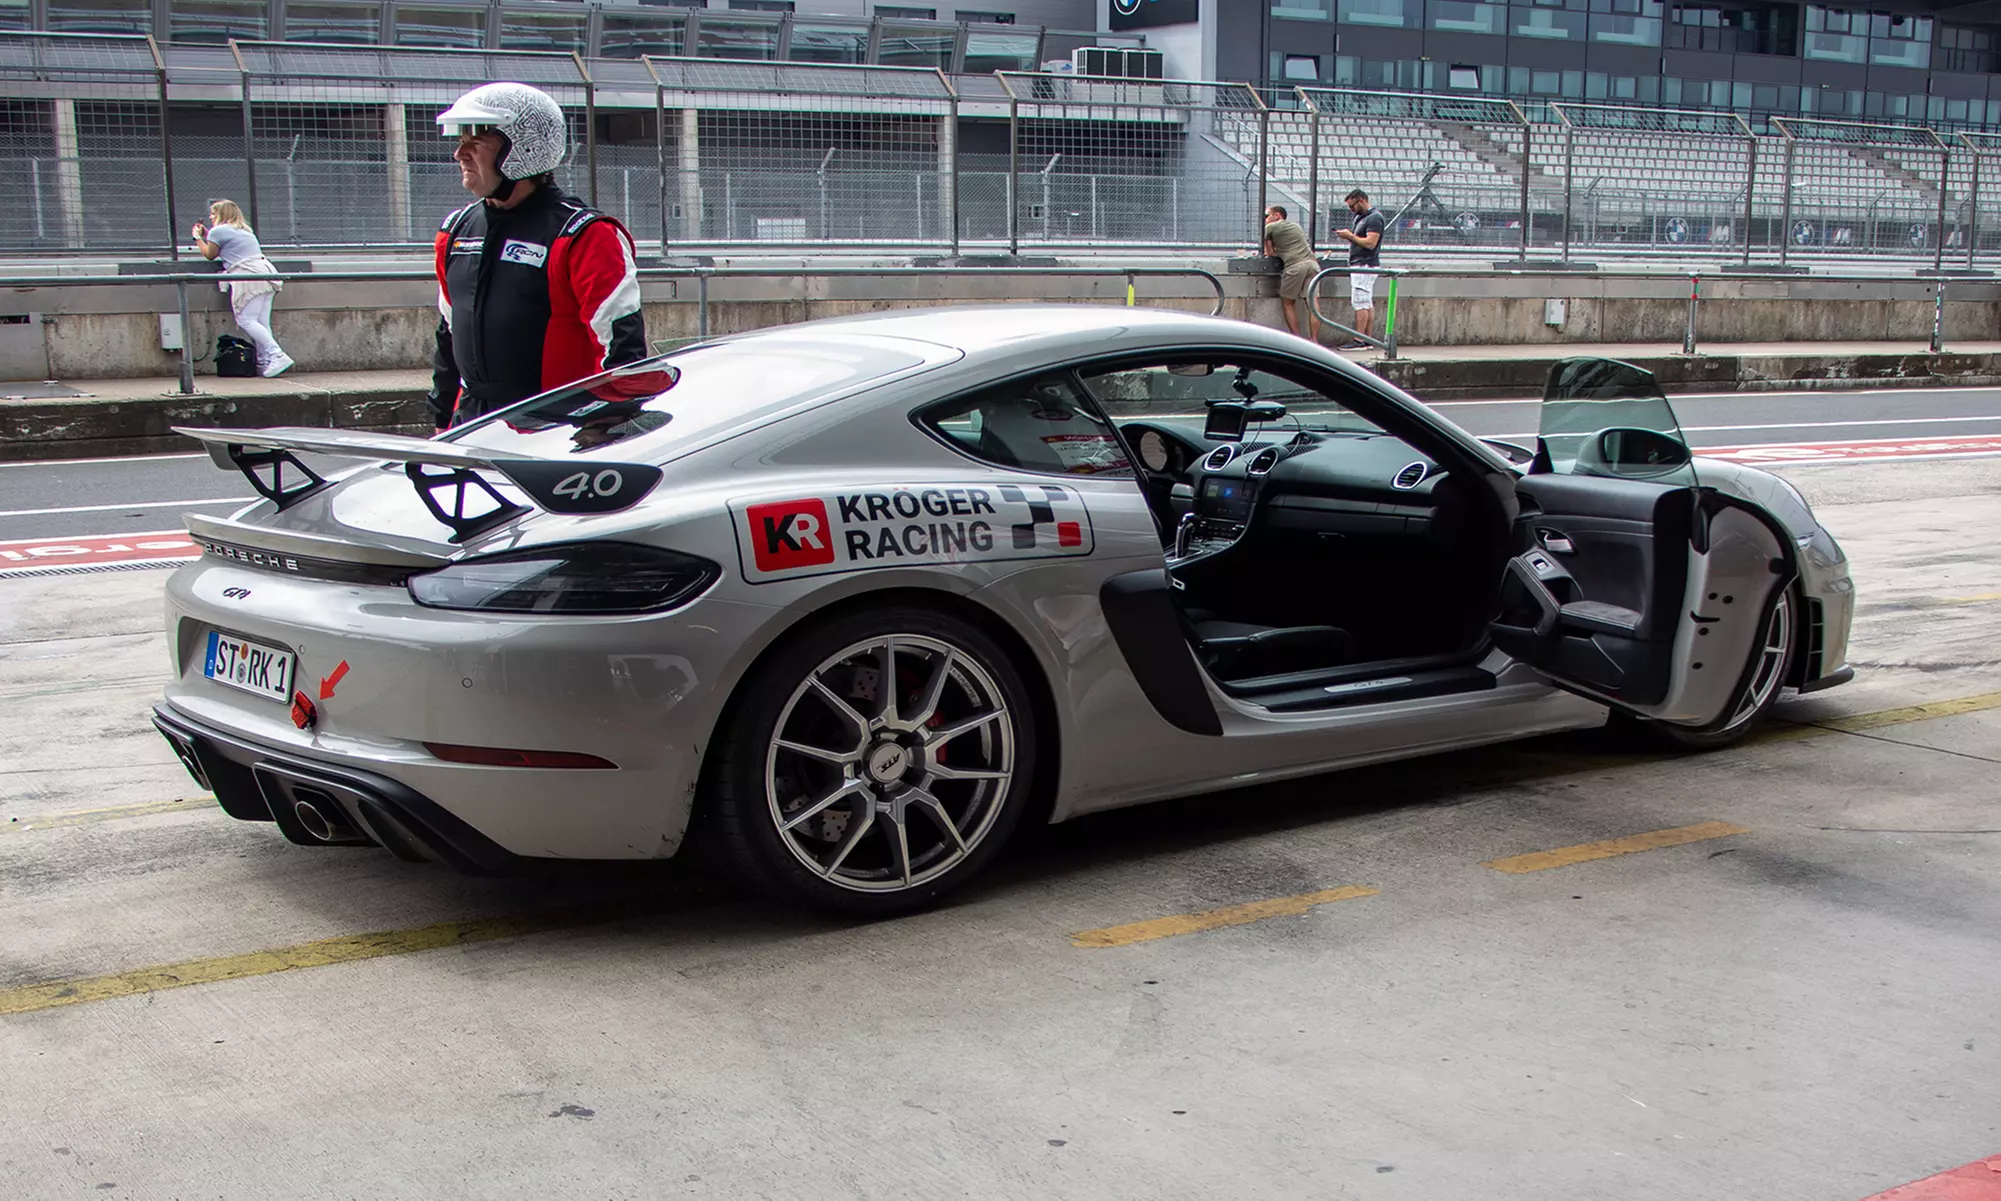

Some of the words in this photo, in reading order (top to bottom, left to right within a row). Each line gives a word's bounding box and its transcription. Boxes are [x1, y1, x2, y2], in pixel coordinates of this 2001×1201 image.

[515, 249, 544, 259] RCN
[552, 469, 623, 500] 4.0
[835, 486, 997, 524] KRÖGER
[763, 512, 825, 555] KR
[844, 521, 994, 561] RACING
[204, 543, 299, 571] PORSCHE
[215, 640, 241, 680] ST
[247, 649, 274, 690] RK
[274, 656, 287, 694] 1
